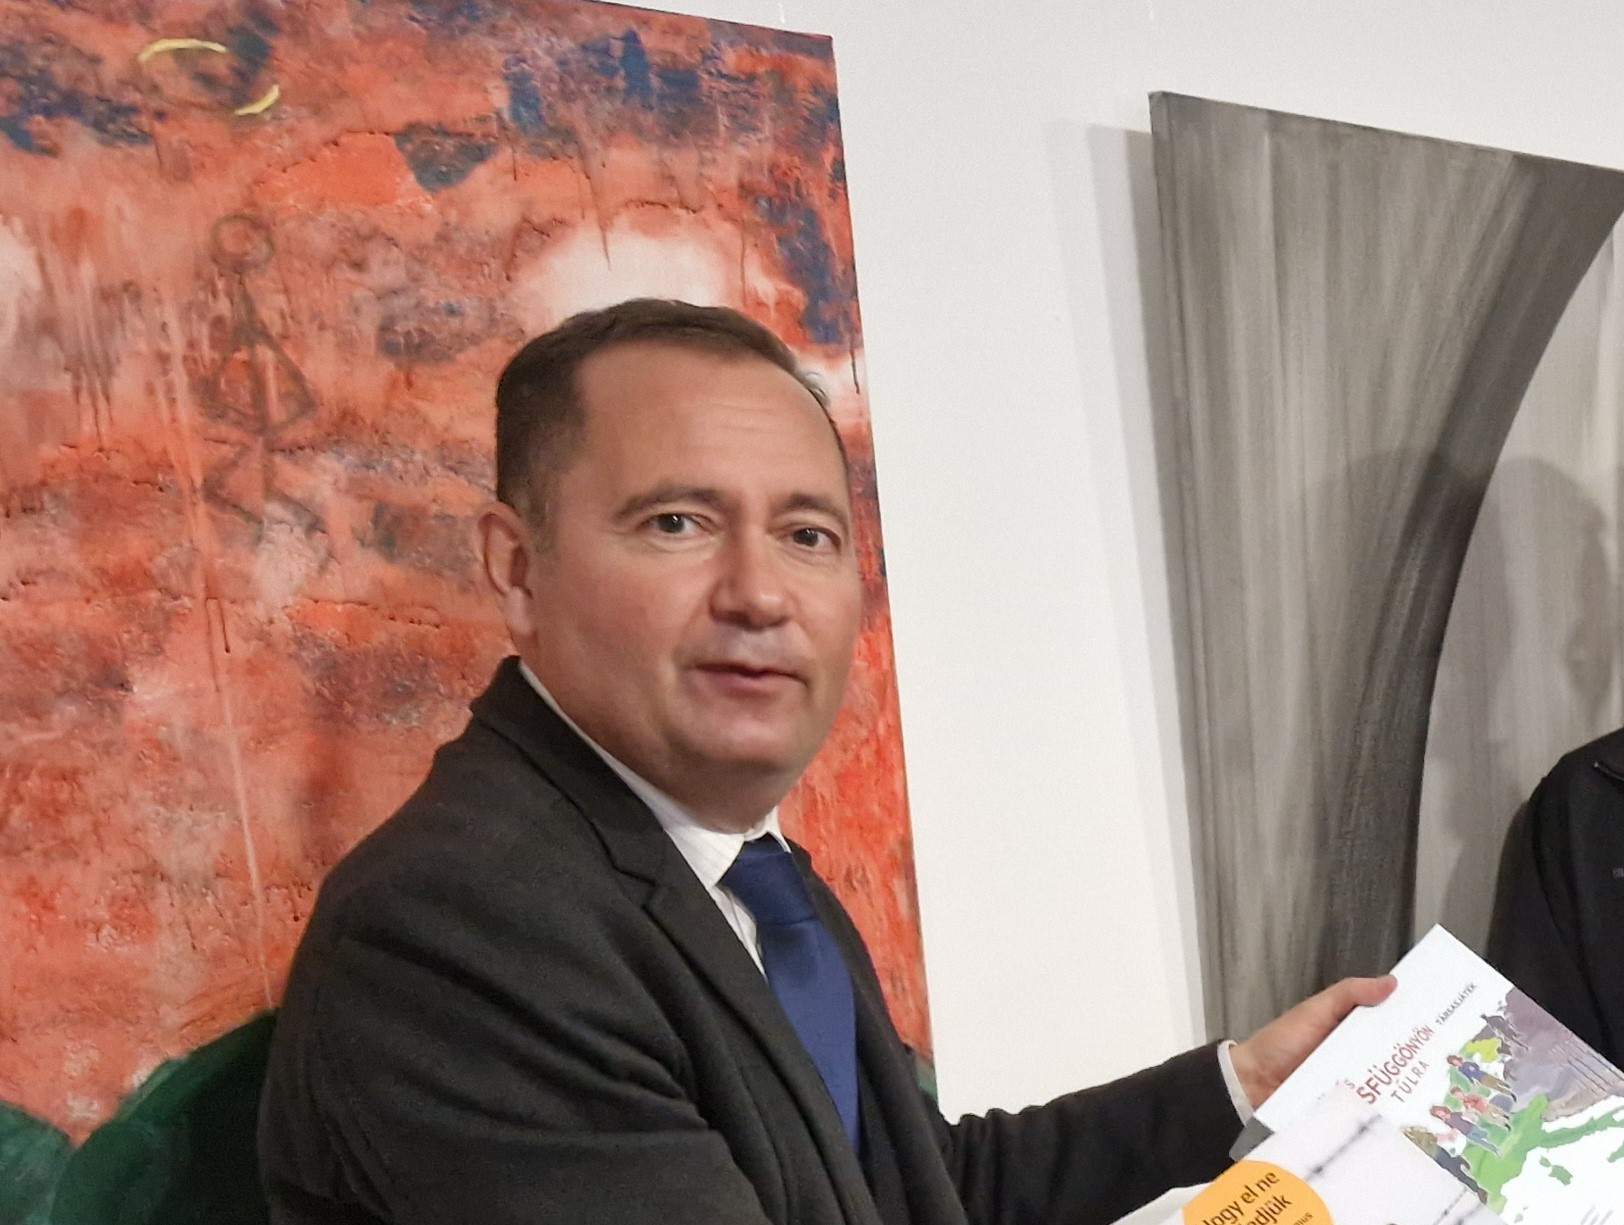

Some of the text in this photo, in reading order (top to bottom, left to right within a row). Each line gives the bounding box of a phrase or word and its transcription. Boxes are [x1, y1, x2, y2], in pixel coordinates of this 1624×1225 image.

[1356, 1025, 1435, 1104] SFÜGGÖNYÖN
[1390, 1060, 1430, 1103] TÚLRA
[1240, 1184, 1259, 1204] el
[1256, 1172, 1280, 1192] ne
